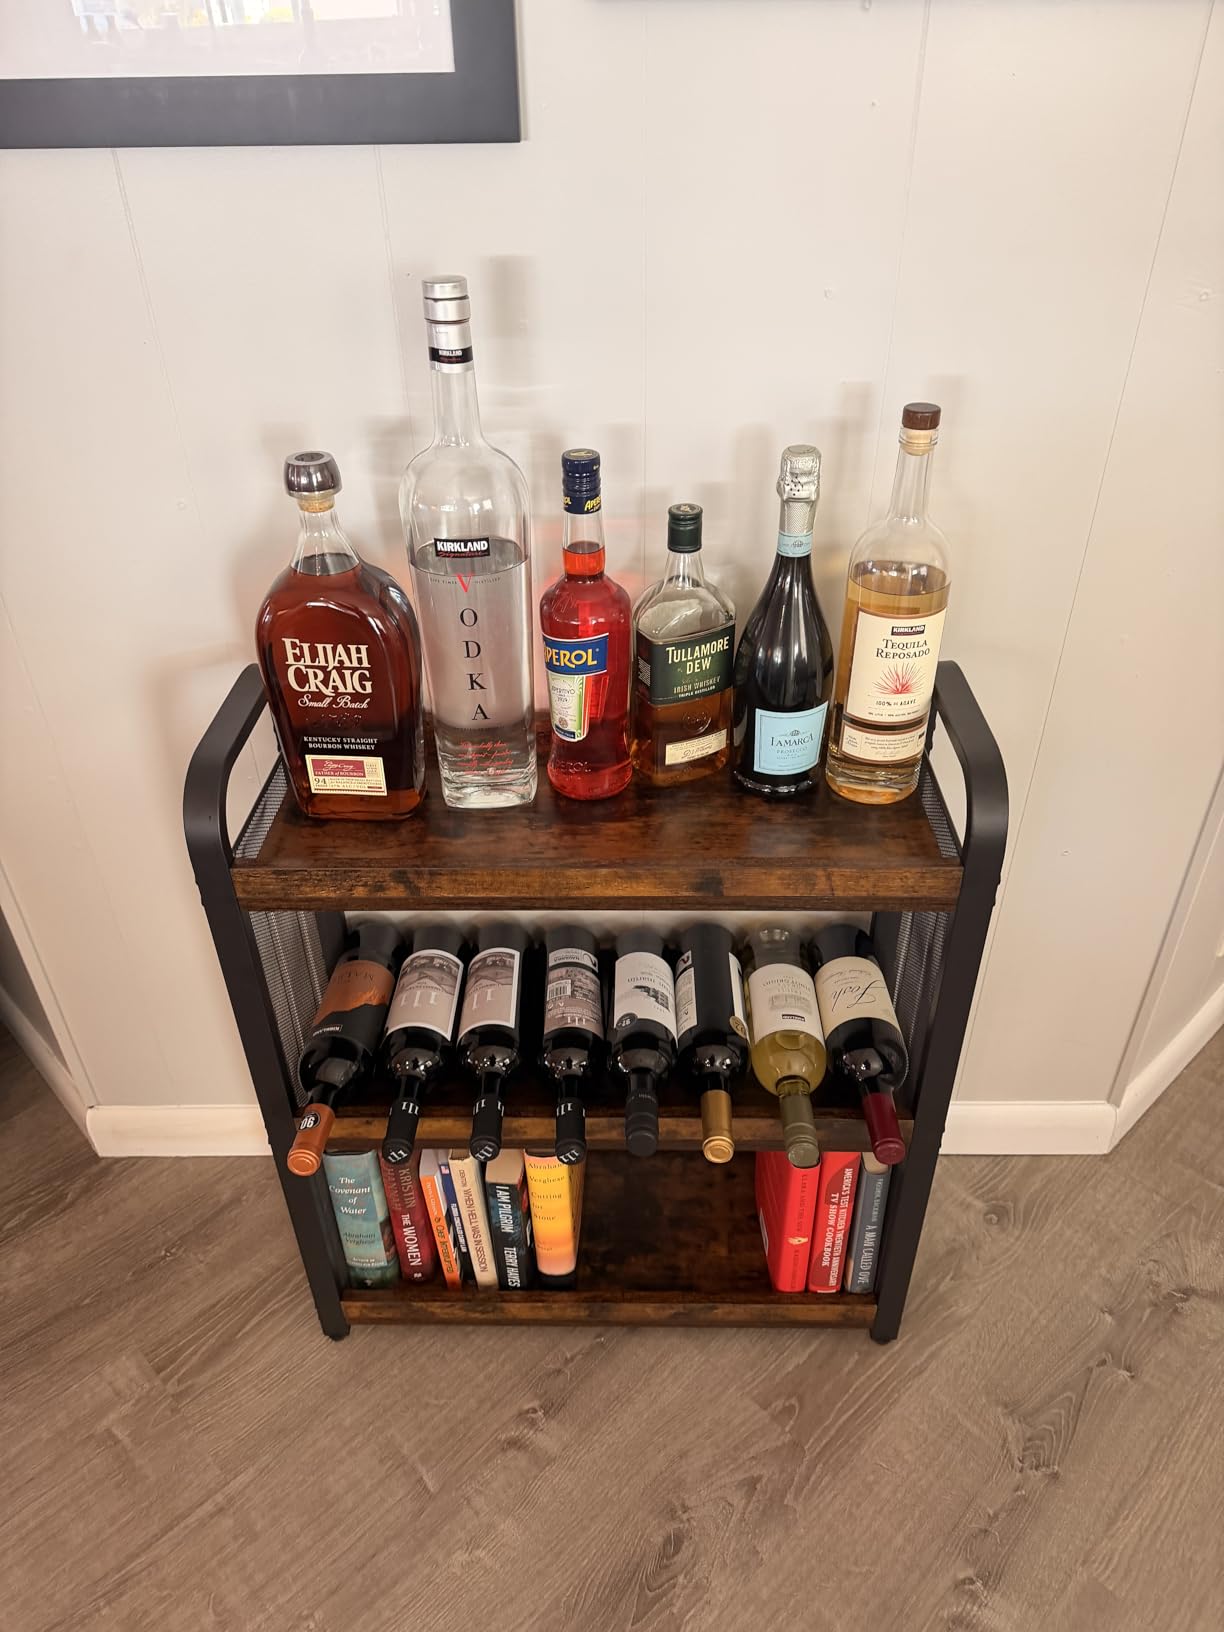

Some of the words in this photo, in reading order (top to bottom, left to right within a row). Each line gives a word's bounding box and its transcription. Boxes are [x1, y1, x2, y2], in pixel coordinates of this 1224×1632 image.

[436, 540, 488, 552] KIRKLAND
[665, 635, 730, 665] TULLAMORE
[882, 638, 928, 650] TEQUILA
[281, 637, 372, 672] ELIJAH
[876, 648, 930, 660] REPOSADO
[686, 657, 712, 675] DEW
[287, 664, 373, 696] CRAIG
[673, 684, 692, 694] IRISH
[694, 675, 721, 690] WHISKEY
[297, 693, 333, 708] Small
[332, 695, 371, 709] Batch
[343, 743, 375, 751] WHISKEY
[314, 777, 327, 785] 94
[831, 979, 886, 1013] Josh
[328, 1184, 371, 1195] Covenant
[338, 1177, 356, 1185] The
[398, 1168, 416, 1208] KRISTIN
[841, 1168, 853, 1196] AMERICA'S
[348, 1196, 357, 1204] of
[463, 1188, 475, 1209] WHEN
[497, 1190, 511, 1203] AM
[830, 1192, 839, 1203] TV
[839, 1196, 849, 1208] TEST
[340, 1206, 367, 1216] Water
[401, 1214, 411, 1226] THE
[467, 1210, 478, 1226] HELL
[498, 1203, 514, 1233] PILGRIM
[827, 1204, 837, 1226] SHOW
[836, 1209, 847, 1230] KITCHEN
[471, 1225, 480, 1239] WAS
[864, 1231, 876, 1247] MAN
[402, 1226, 422, 1267] WOMEN
[821, 1227, 835, 1267] COOKBOOK
[832, 1230, 845, 1257] TWENTIETH
[475, 1246, 488, 1273] SESSION
[504, 1247, 518, 1267] TERRY
[860, 1248, 874, 1270] CALLED
[507, 1266, 520, 1287] HAYES
[828, 1256, 840, 1287] ANNIVERSARY
[857, 1271, 871, 1284] OVE
